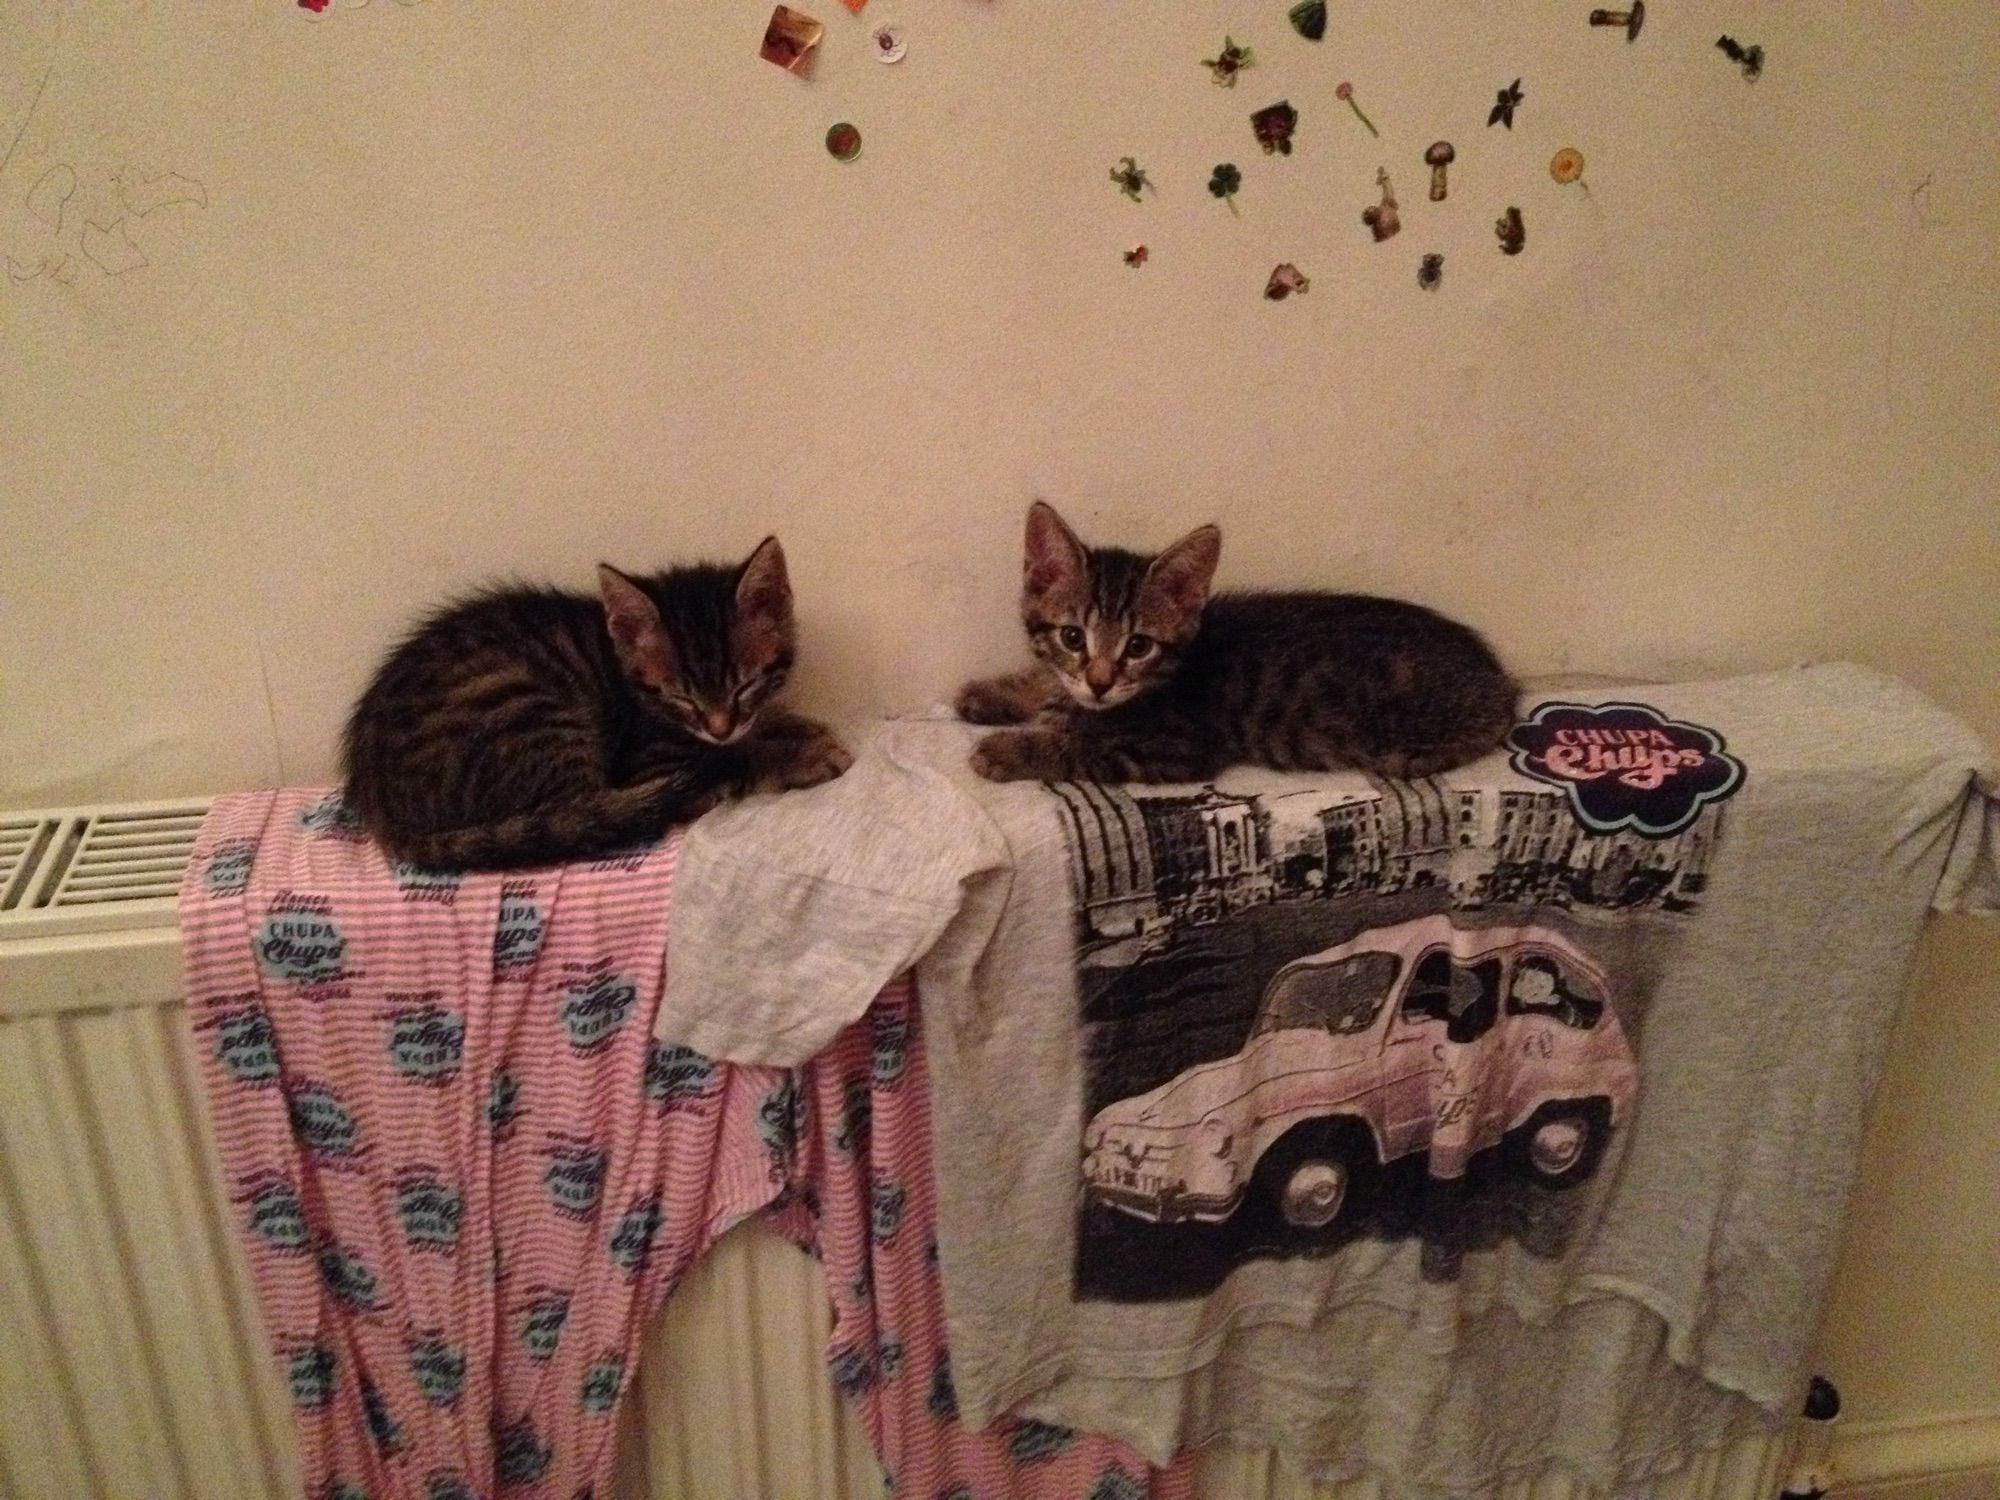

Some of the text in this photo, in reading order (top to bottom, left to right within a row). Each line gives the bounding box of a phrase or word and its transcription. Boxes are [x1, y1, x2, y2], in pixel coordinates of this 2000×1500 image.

[1556, 729, 1675, 745] CHUPA
[1534, 745, 1705, 789] Chups
[499, 907, 536, 922] UPA
[270, 922, 336, 938] CHUPA
[263, 938, 345, 967] Chups
